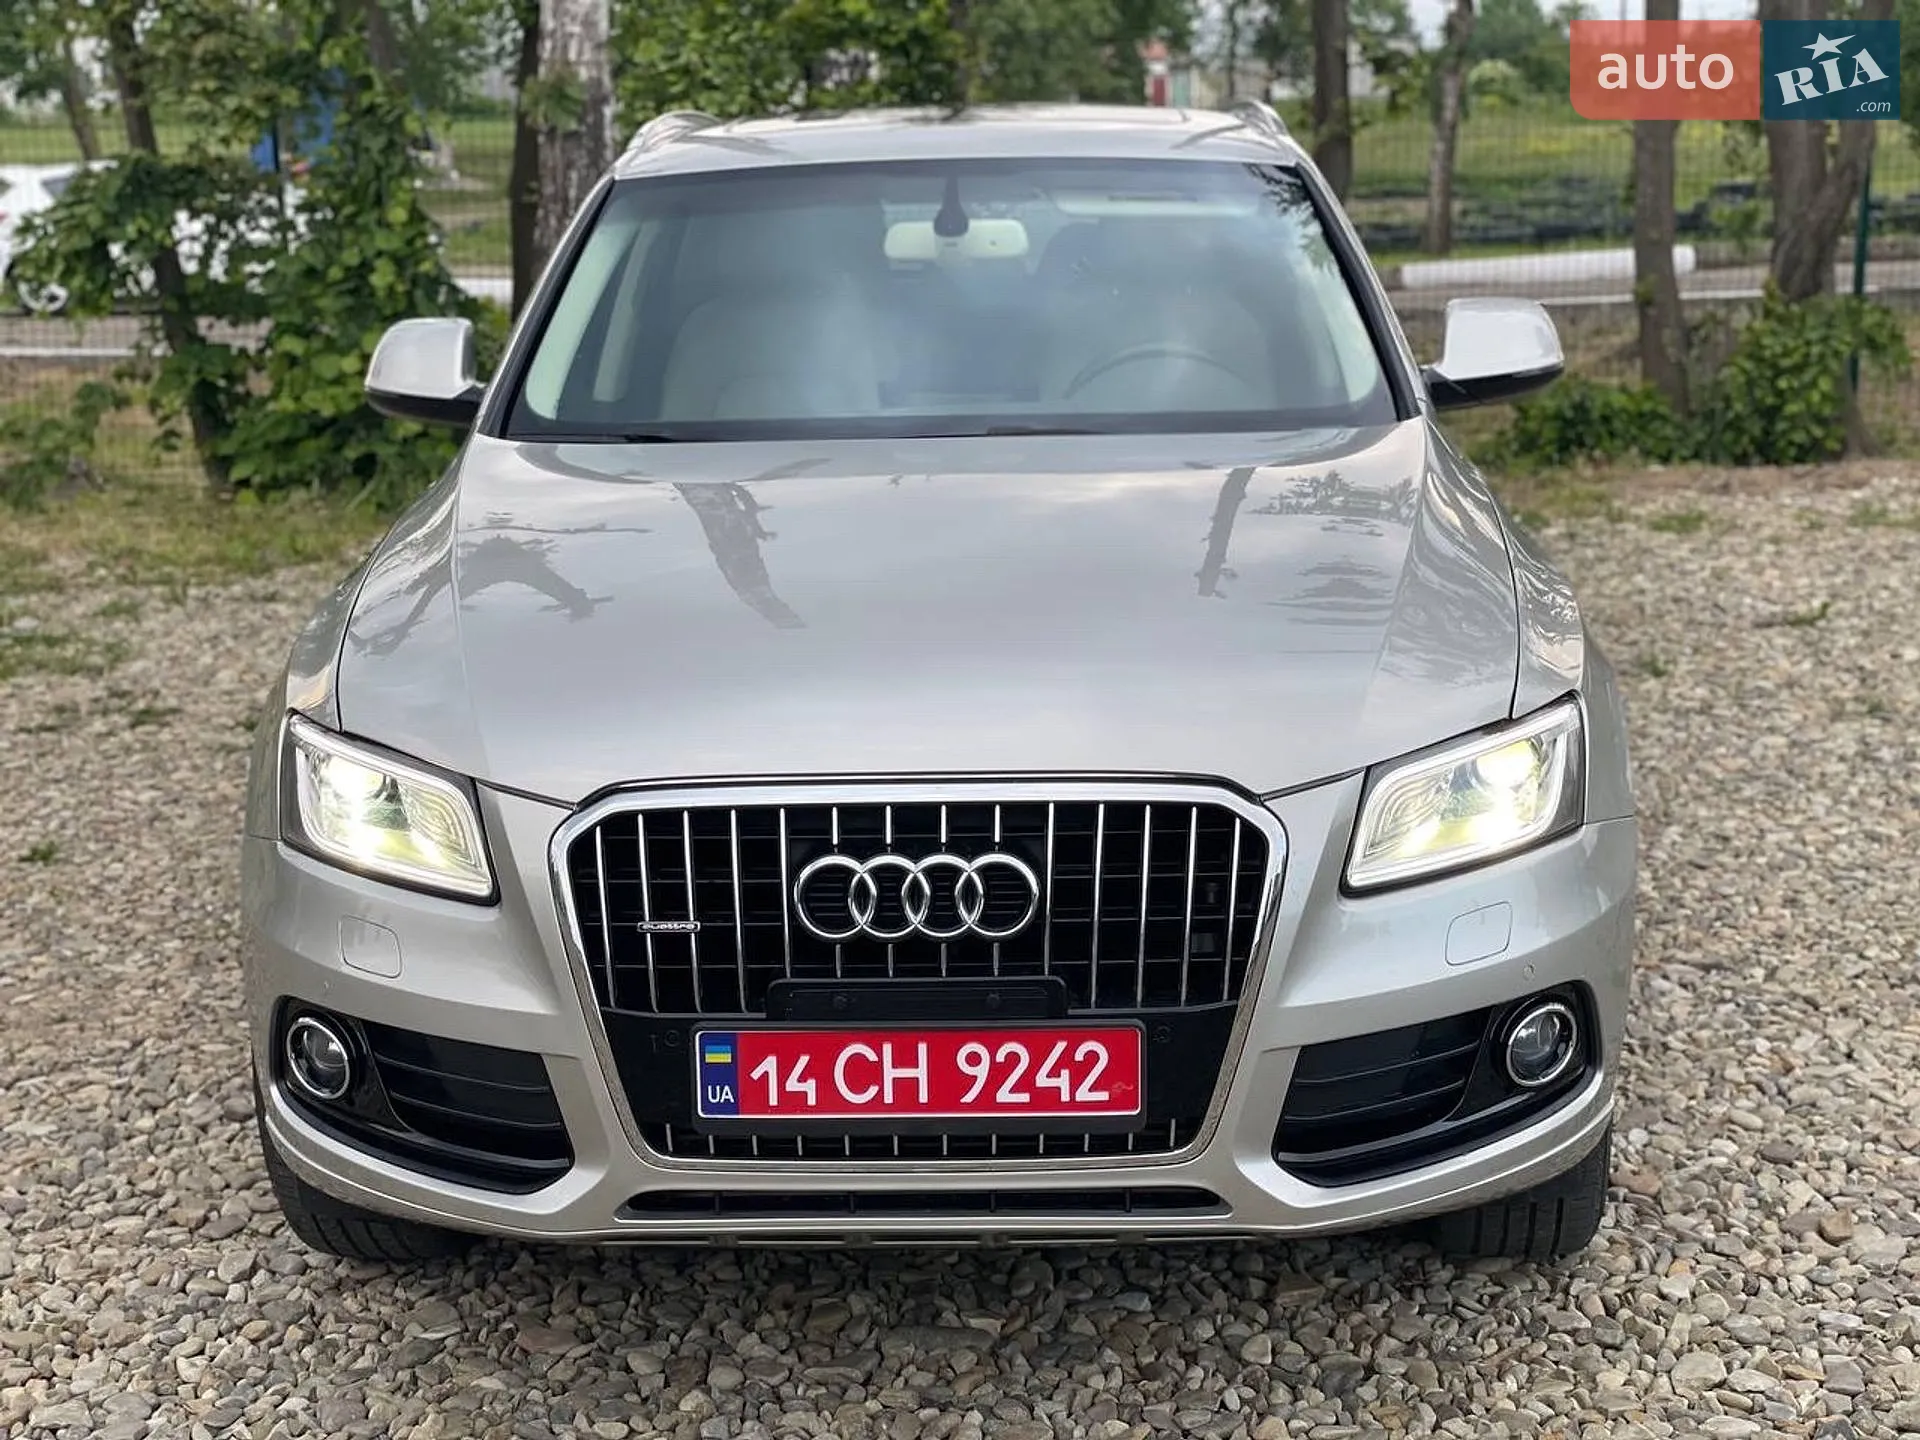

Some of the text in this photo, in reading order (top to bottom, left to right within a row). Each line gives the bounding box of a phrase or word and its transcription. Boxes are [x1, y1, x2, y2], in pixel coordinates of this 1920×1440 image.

[707, 1085, 734, 1103] UA
[749, 1040, 1109, 1106] 14 CH 9242
